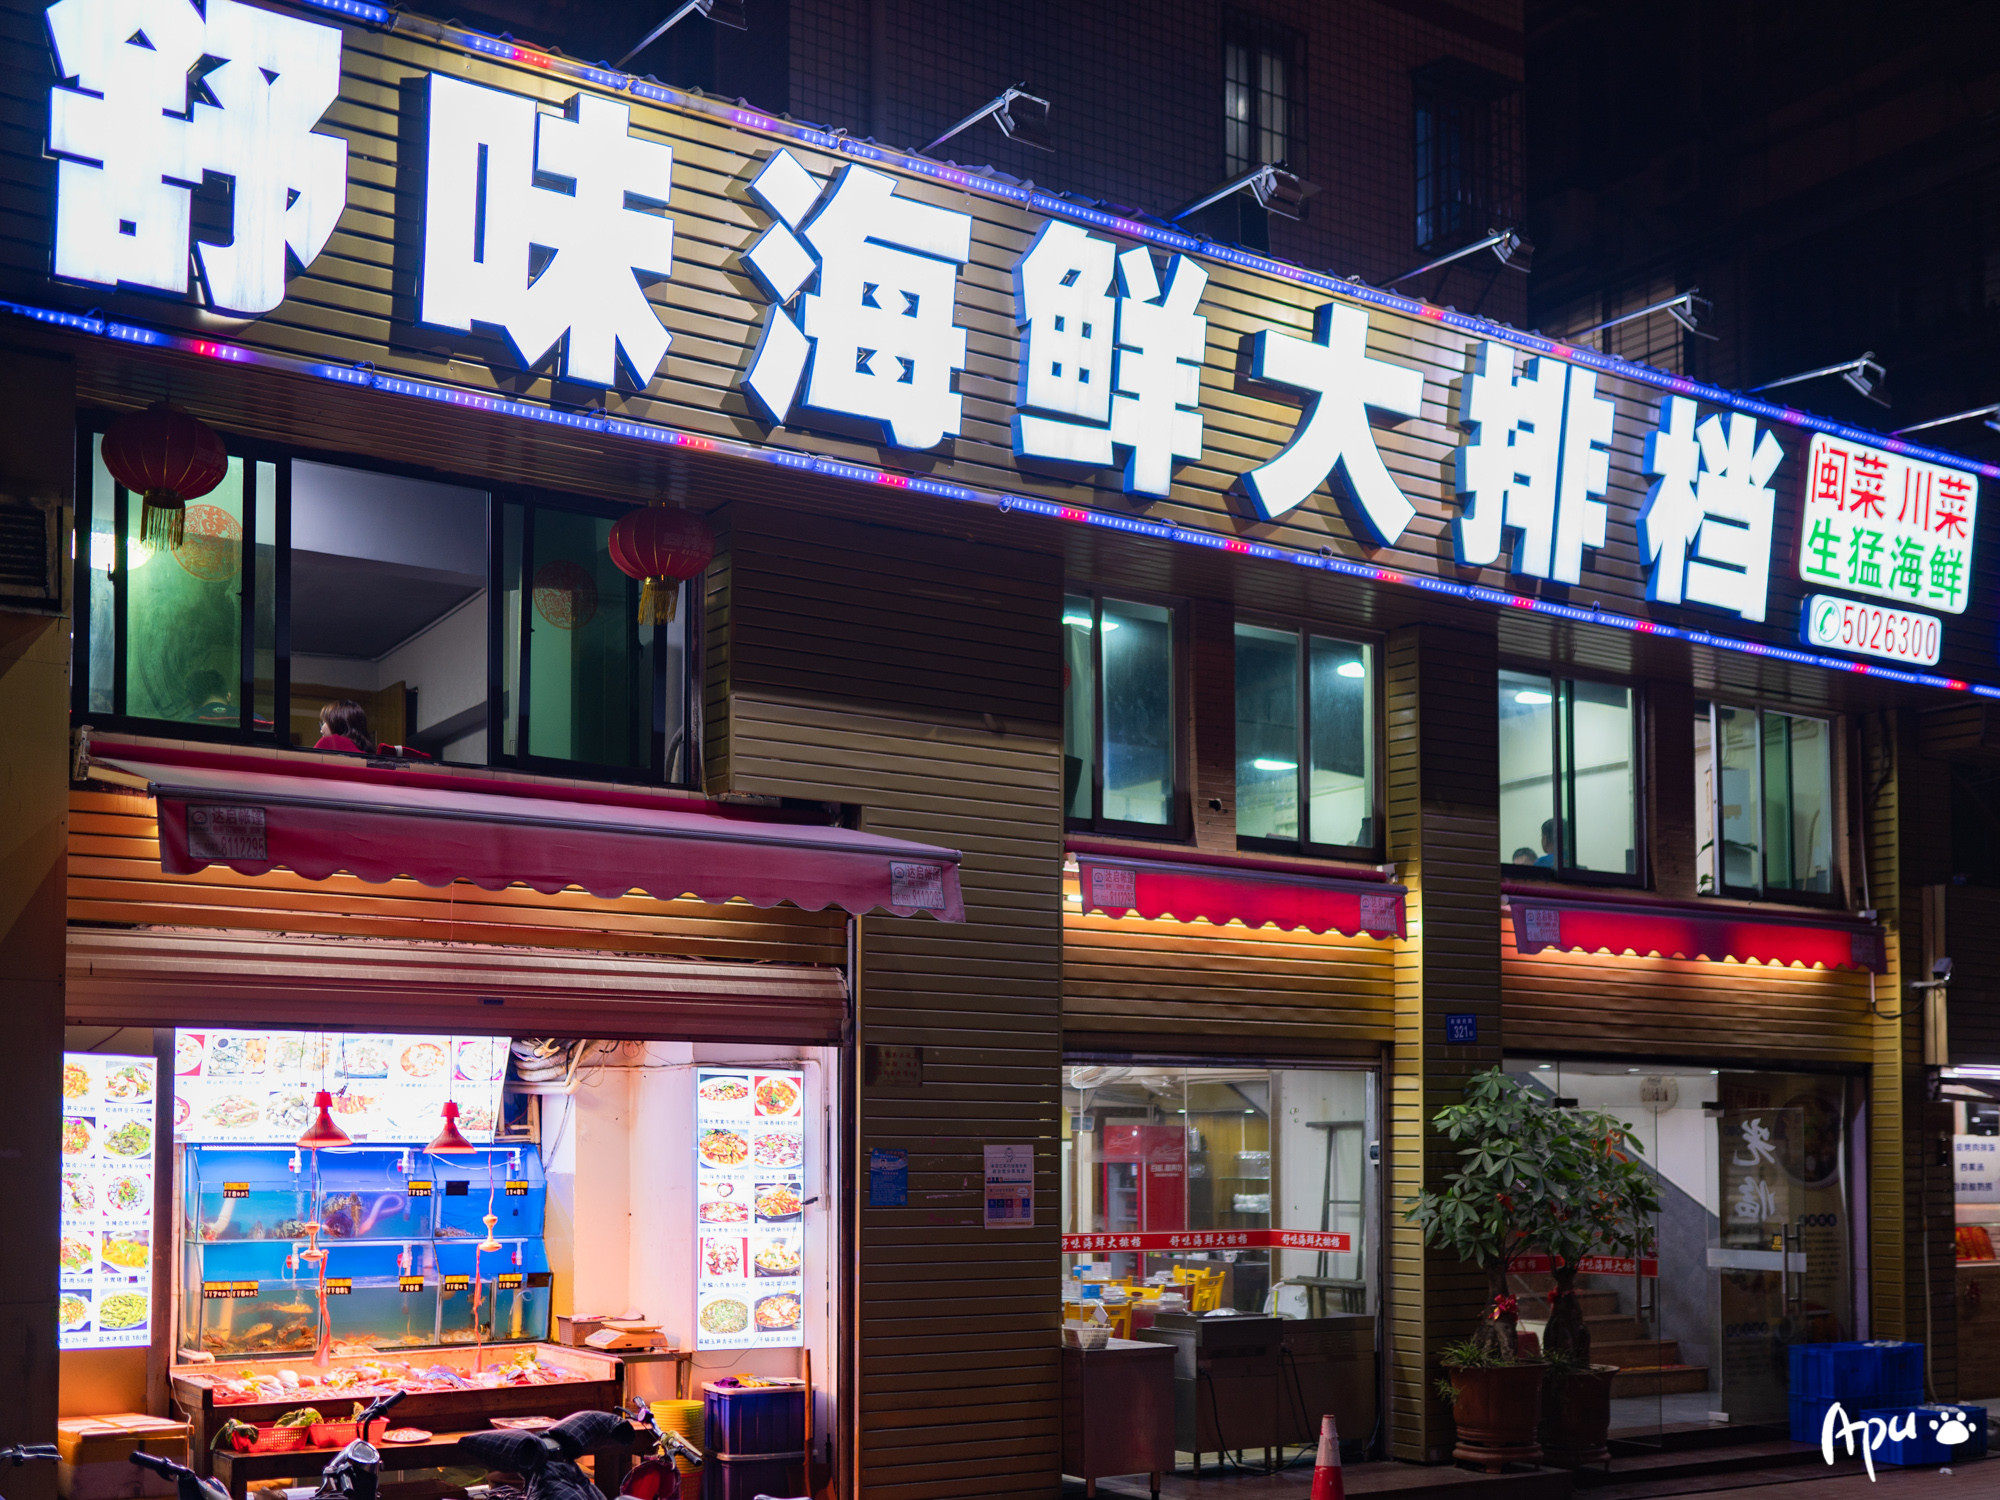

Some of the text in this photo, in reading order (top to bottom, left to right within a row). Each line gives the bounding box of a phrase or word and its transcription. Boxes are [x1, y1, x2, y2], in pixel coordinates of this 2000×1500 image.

[45, 0, 1784, 622] 舒味海鲜大排档
[1811, 441, 1971, 540] 闽菜 川菜
[1806, 517, 1963, 608] 生猛海鲜
[1842, 605, 1937, 660] 5026300
[1169, 1234, 1248, 1247] 舒味海鲜大排档
[1281, 1234, 1340, 1247] 舒味海鲜大排档
